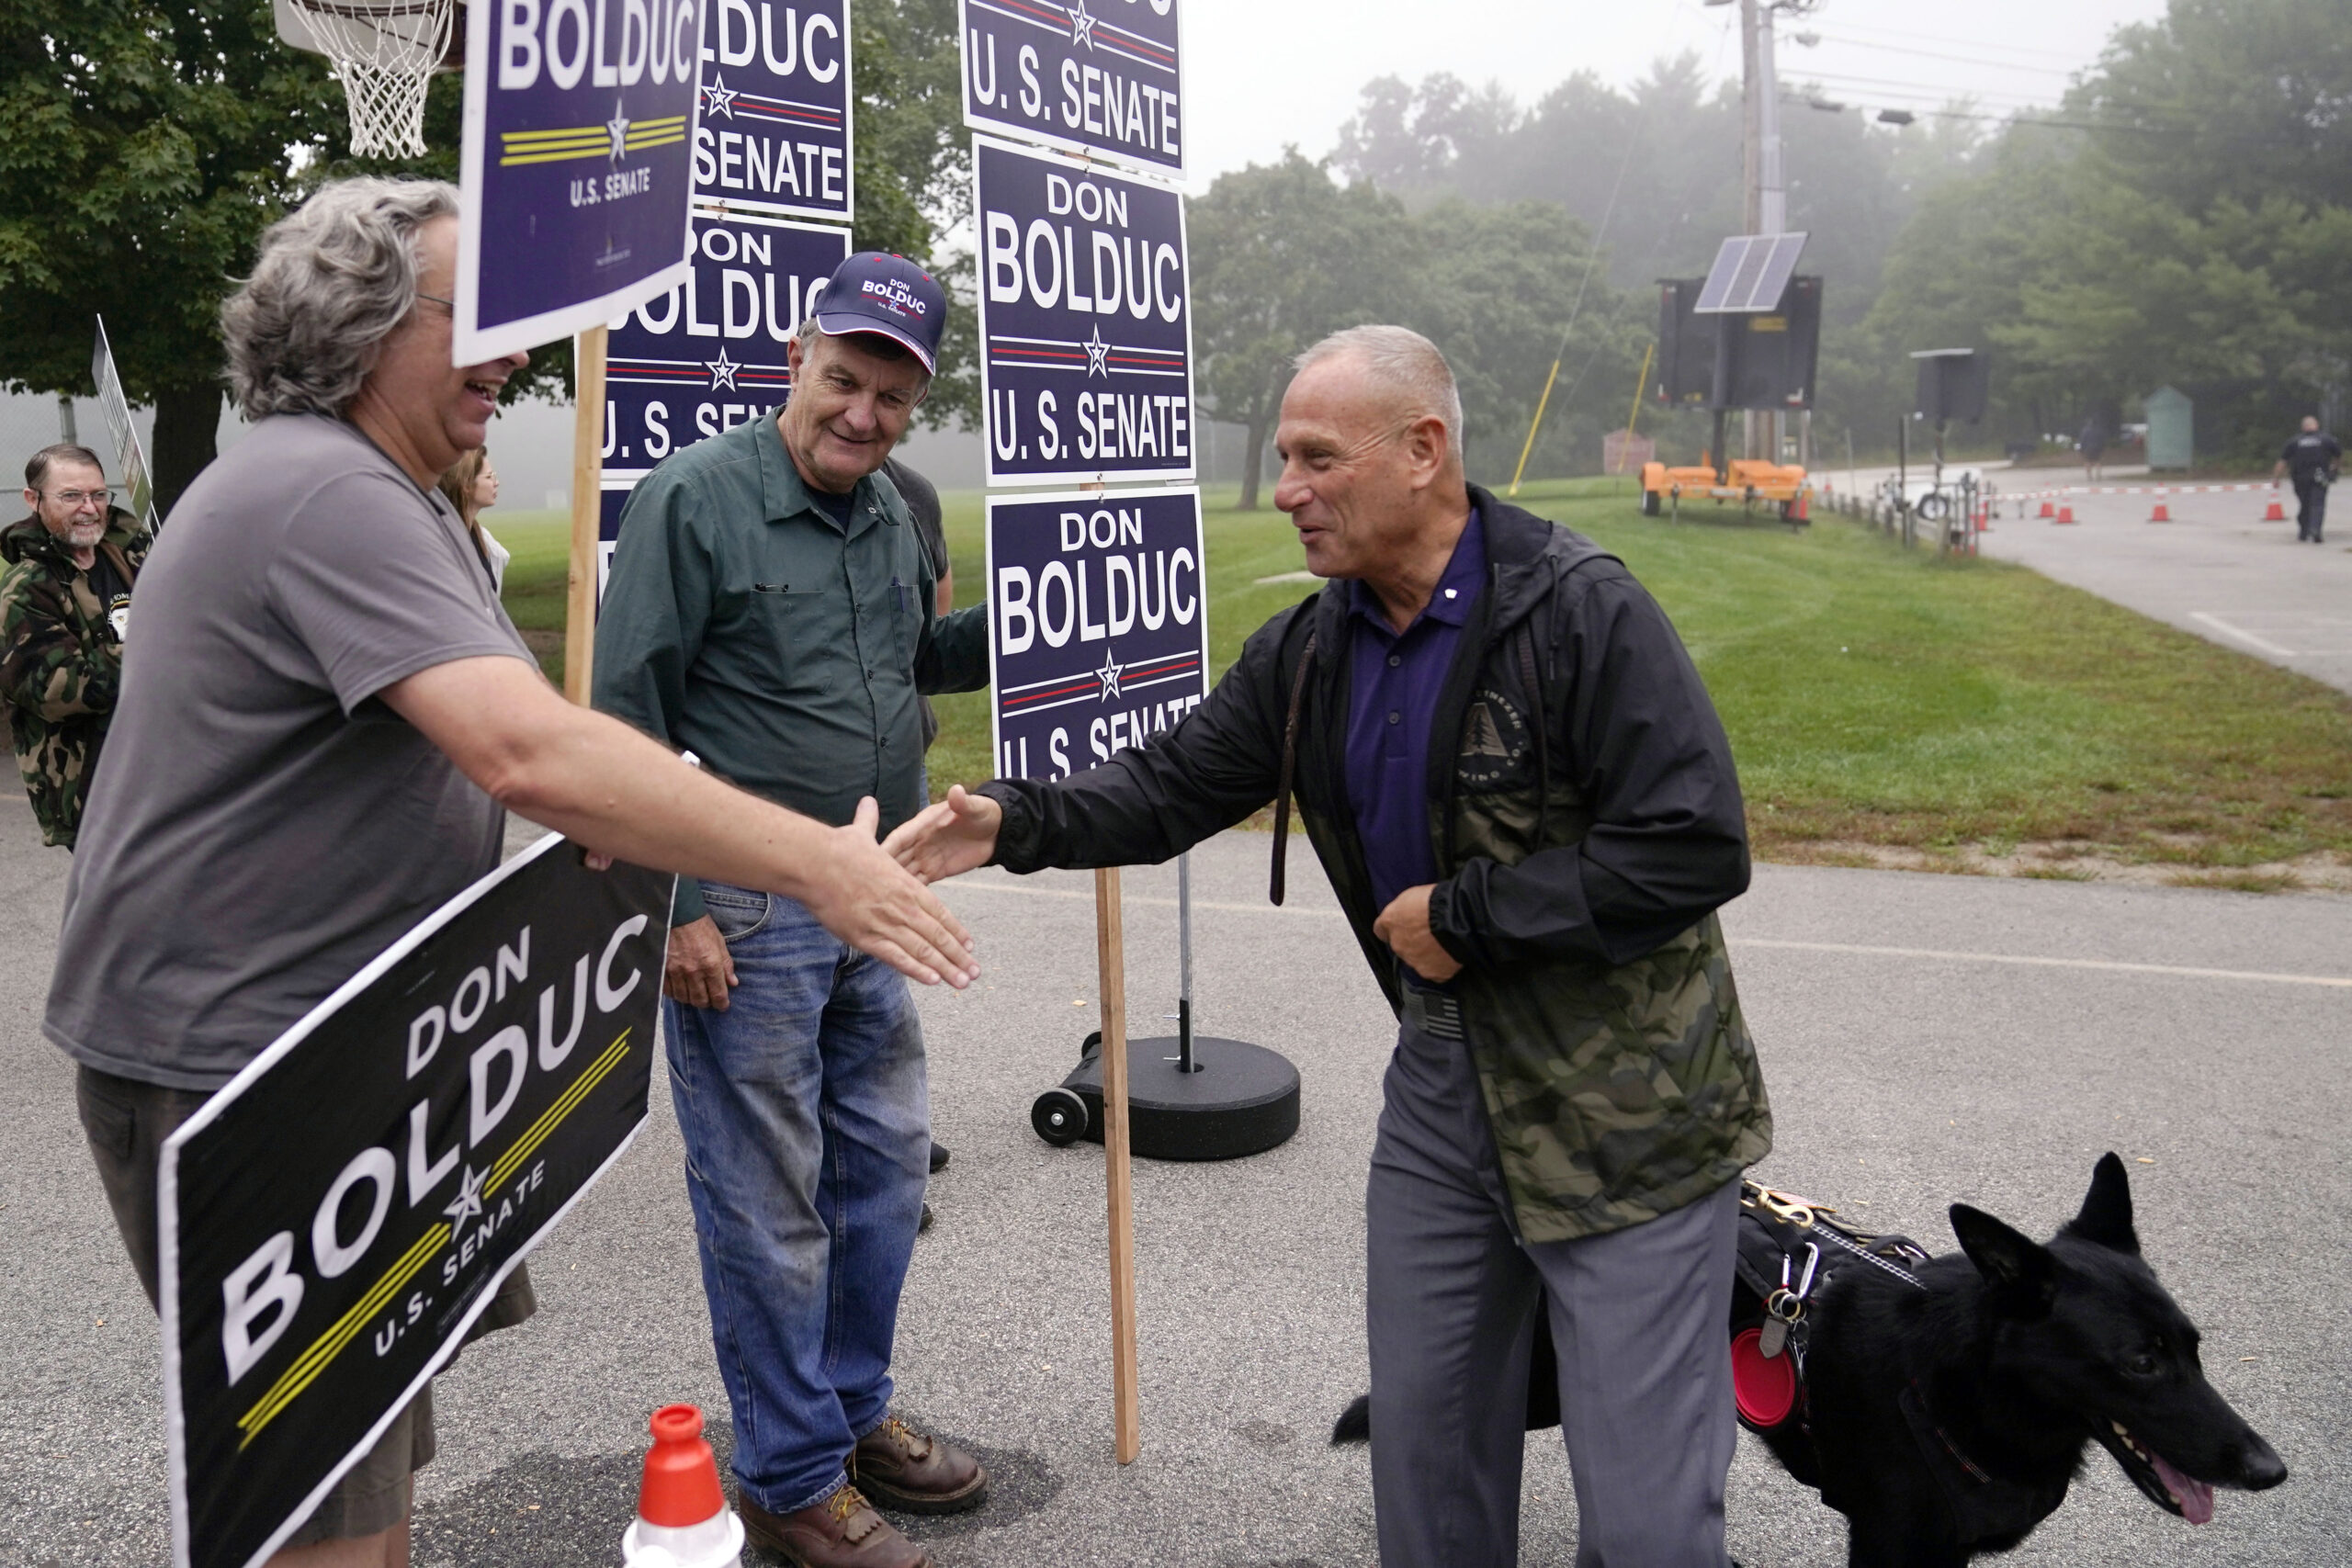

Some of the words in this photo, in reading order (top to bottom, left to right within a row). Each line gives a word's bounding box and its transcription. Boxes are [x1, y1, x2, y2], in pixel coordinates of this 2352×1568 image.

[497, 0, 696, 90] BOLDUC
[702, 0, 840, 84] DUC
[970, 28, 1008, 108] U.
[1018, 44, 1051, 121] S.
[1060, 58, 1179, 156] SENATE
[570, 181, 601, 208] U.S.
[605, 167, 650, 202] SENATE
[695, 127, 843, 201] SENATE
[1046, 173, 1129, 229] DON
[862, 280, 926, 314] BOLDUC
[889, 278, 910, 292] DON
[986, 210, 1182, 323] BOLDUC
[992, 389, 1028, 460] U.
[1037, 389, 1068, 460] S.
[1077, 390, 1188, 459] SENATE
[1059, 508, 1143, 552] DON
[998, 547, 1196, 656] BOLDUC
[1049, 727, 1071, 784] S
[406, 926, 530, 1079] DON
[223, 915, 648, 1385] BOLDUC
[375, 1293, 433, 1358] U.S.
[442, 1160, 545, 1286] SENATE
